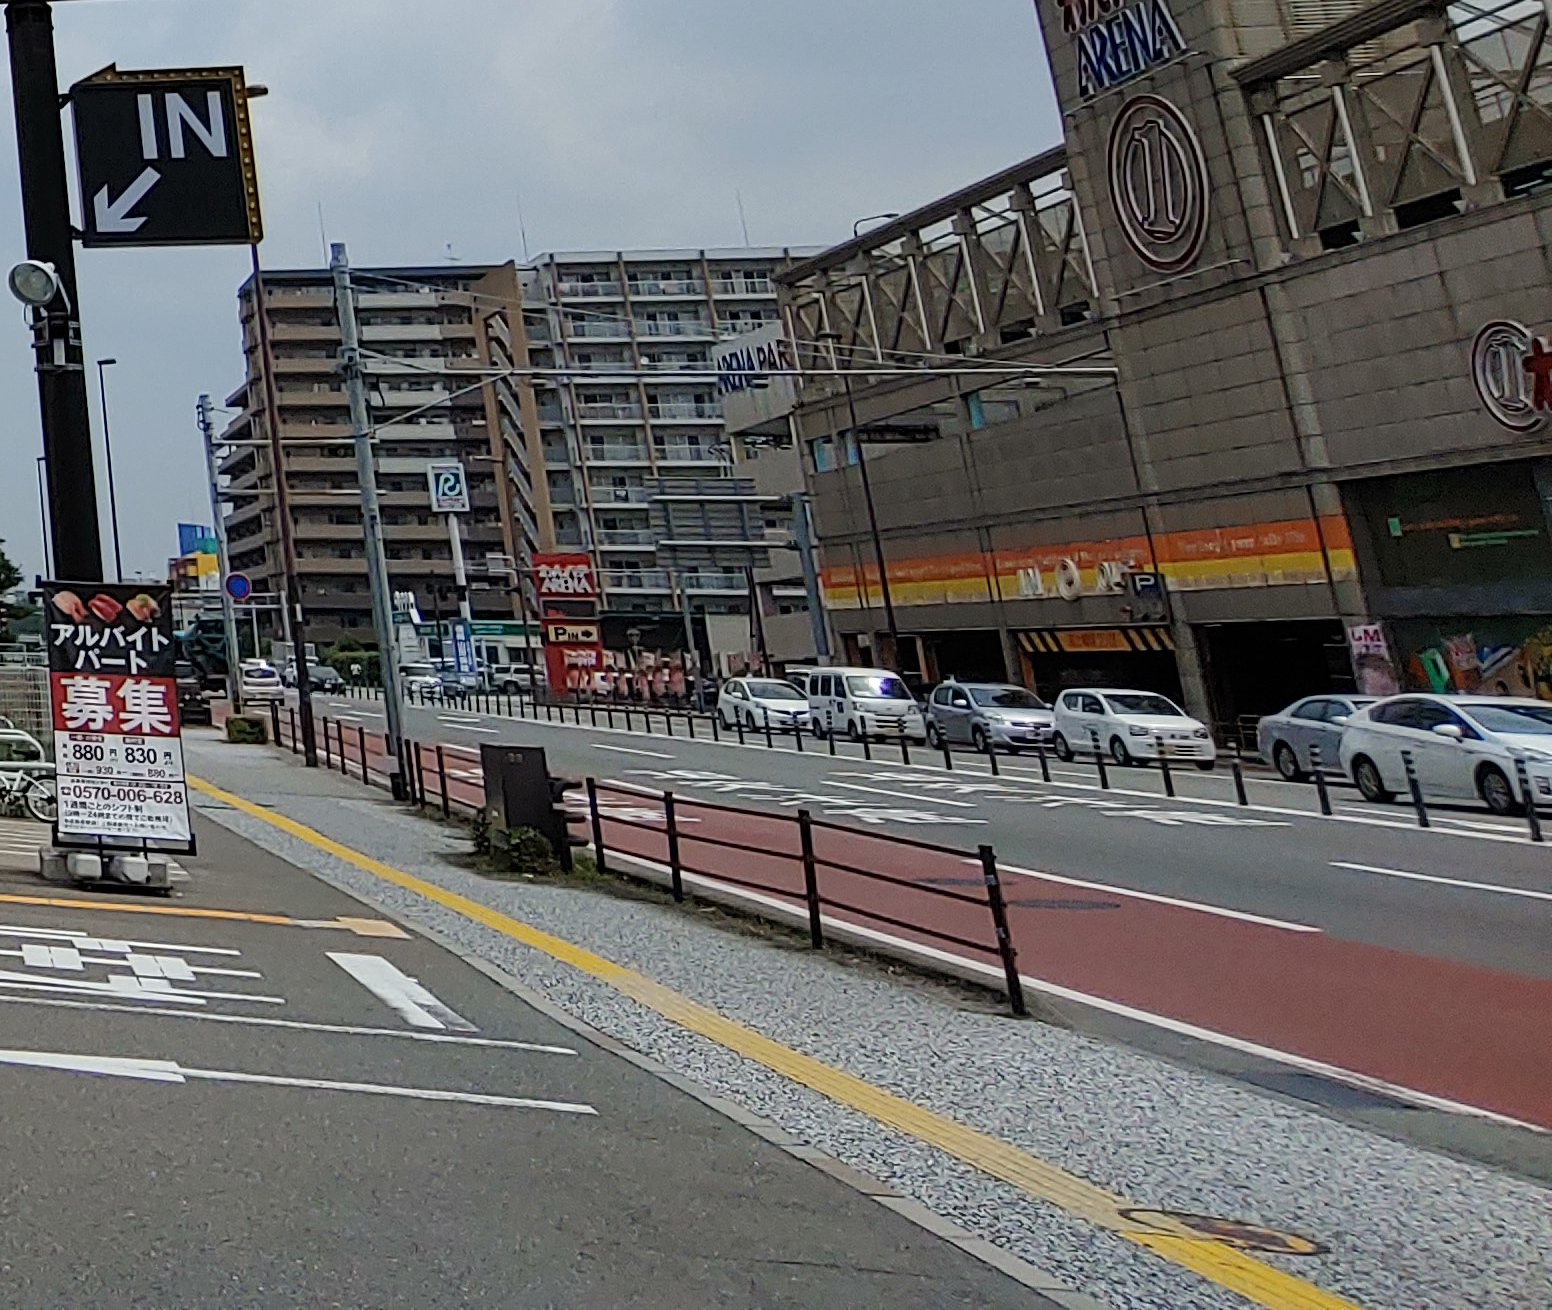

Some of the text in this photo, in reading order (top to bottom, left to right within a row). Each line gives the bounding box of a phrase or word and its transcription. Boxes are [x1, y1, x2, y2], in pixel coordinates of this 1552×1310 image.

[136, 90, 229, 160] IN
[50, 623, 170, 652] アルバイト
[74, 648, 148, 675] パート
[59, 675, 173, 734] 募集
[72, 743, 105, 762] 880
[124, 746, 158, 765] 830
[72, 785, 184, 805] 0570-006-628
